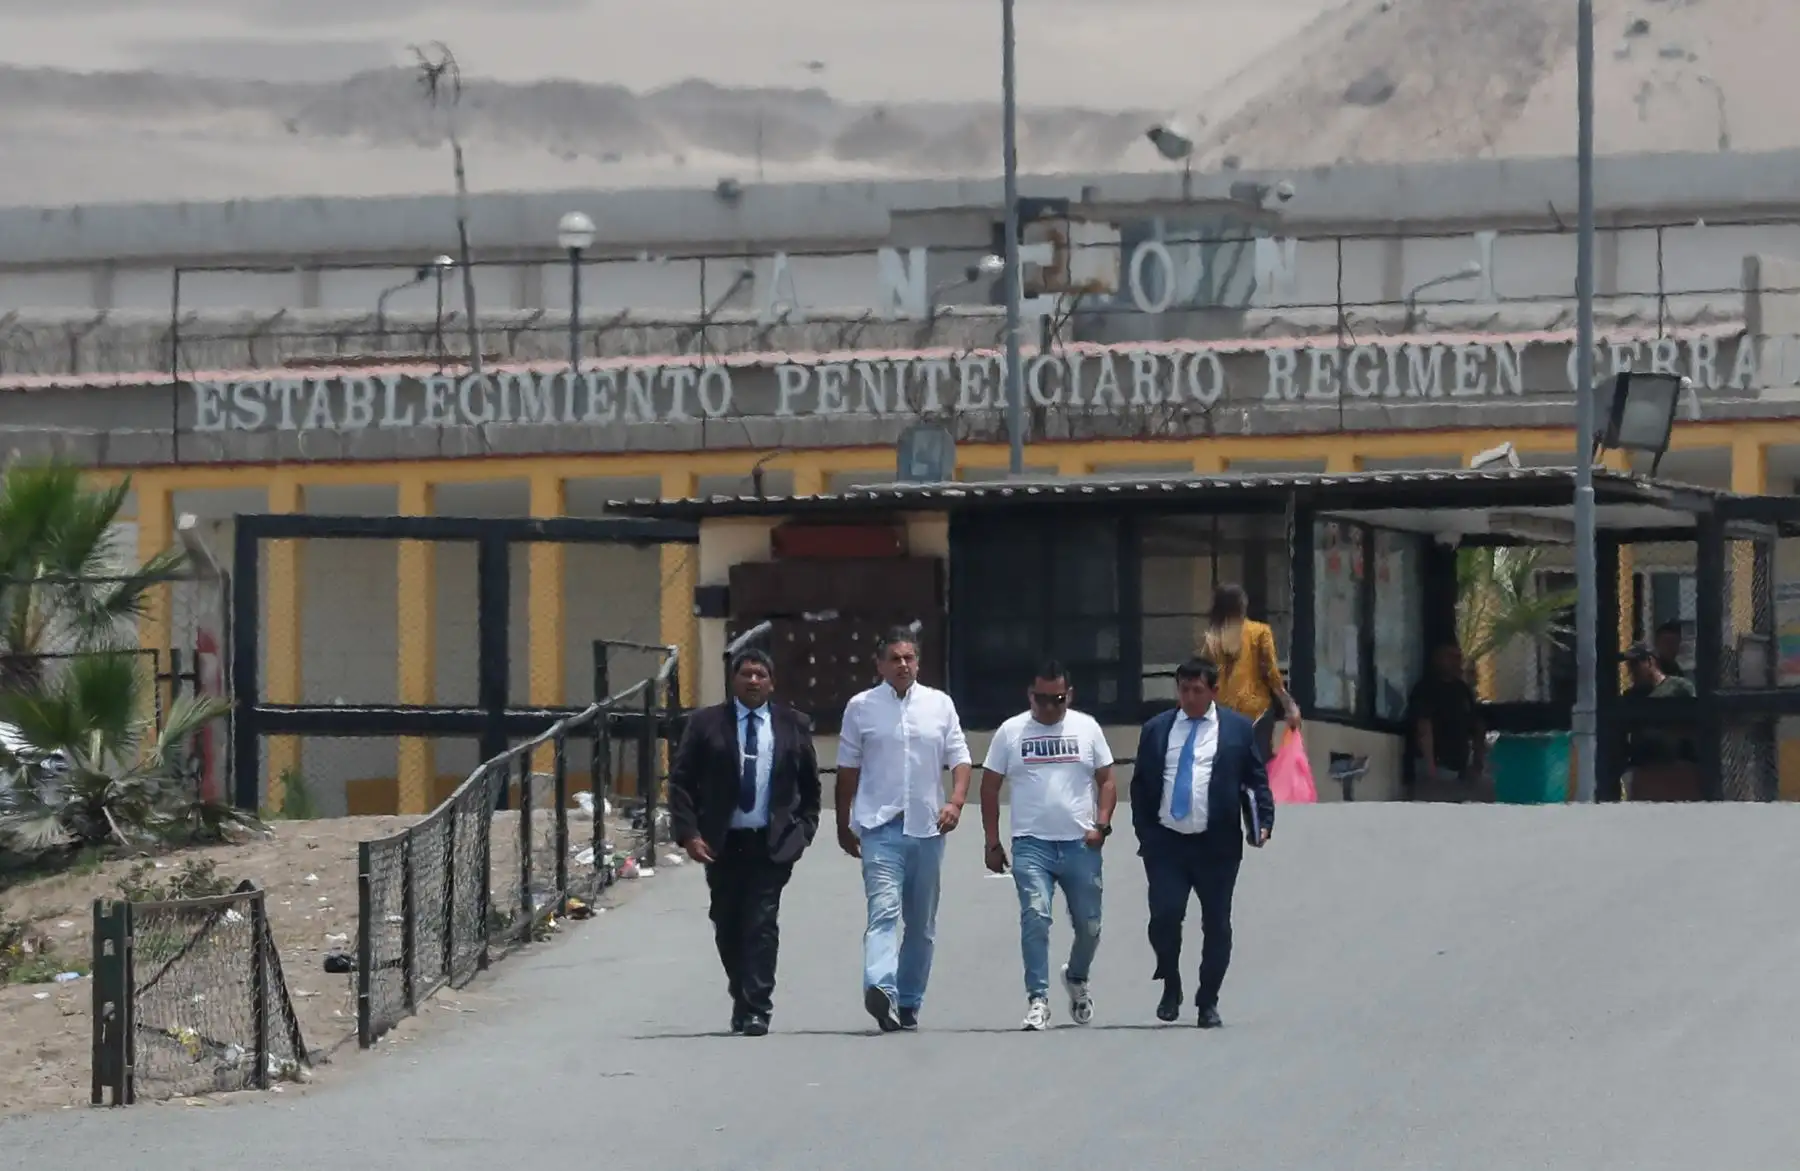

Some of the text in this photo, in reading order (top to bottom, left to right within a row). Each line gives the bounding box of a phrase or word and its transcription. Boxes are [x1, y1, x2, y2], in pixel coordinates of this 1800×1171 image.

[192, 364, 733, 432] ESTABLECIMIENTO
[1263, 339, 1525, 400] REGIMEN
[1021, 740, 1079, 757] PUMA
